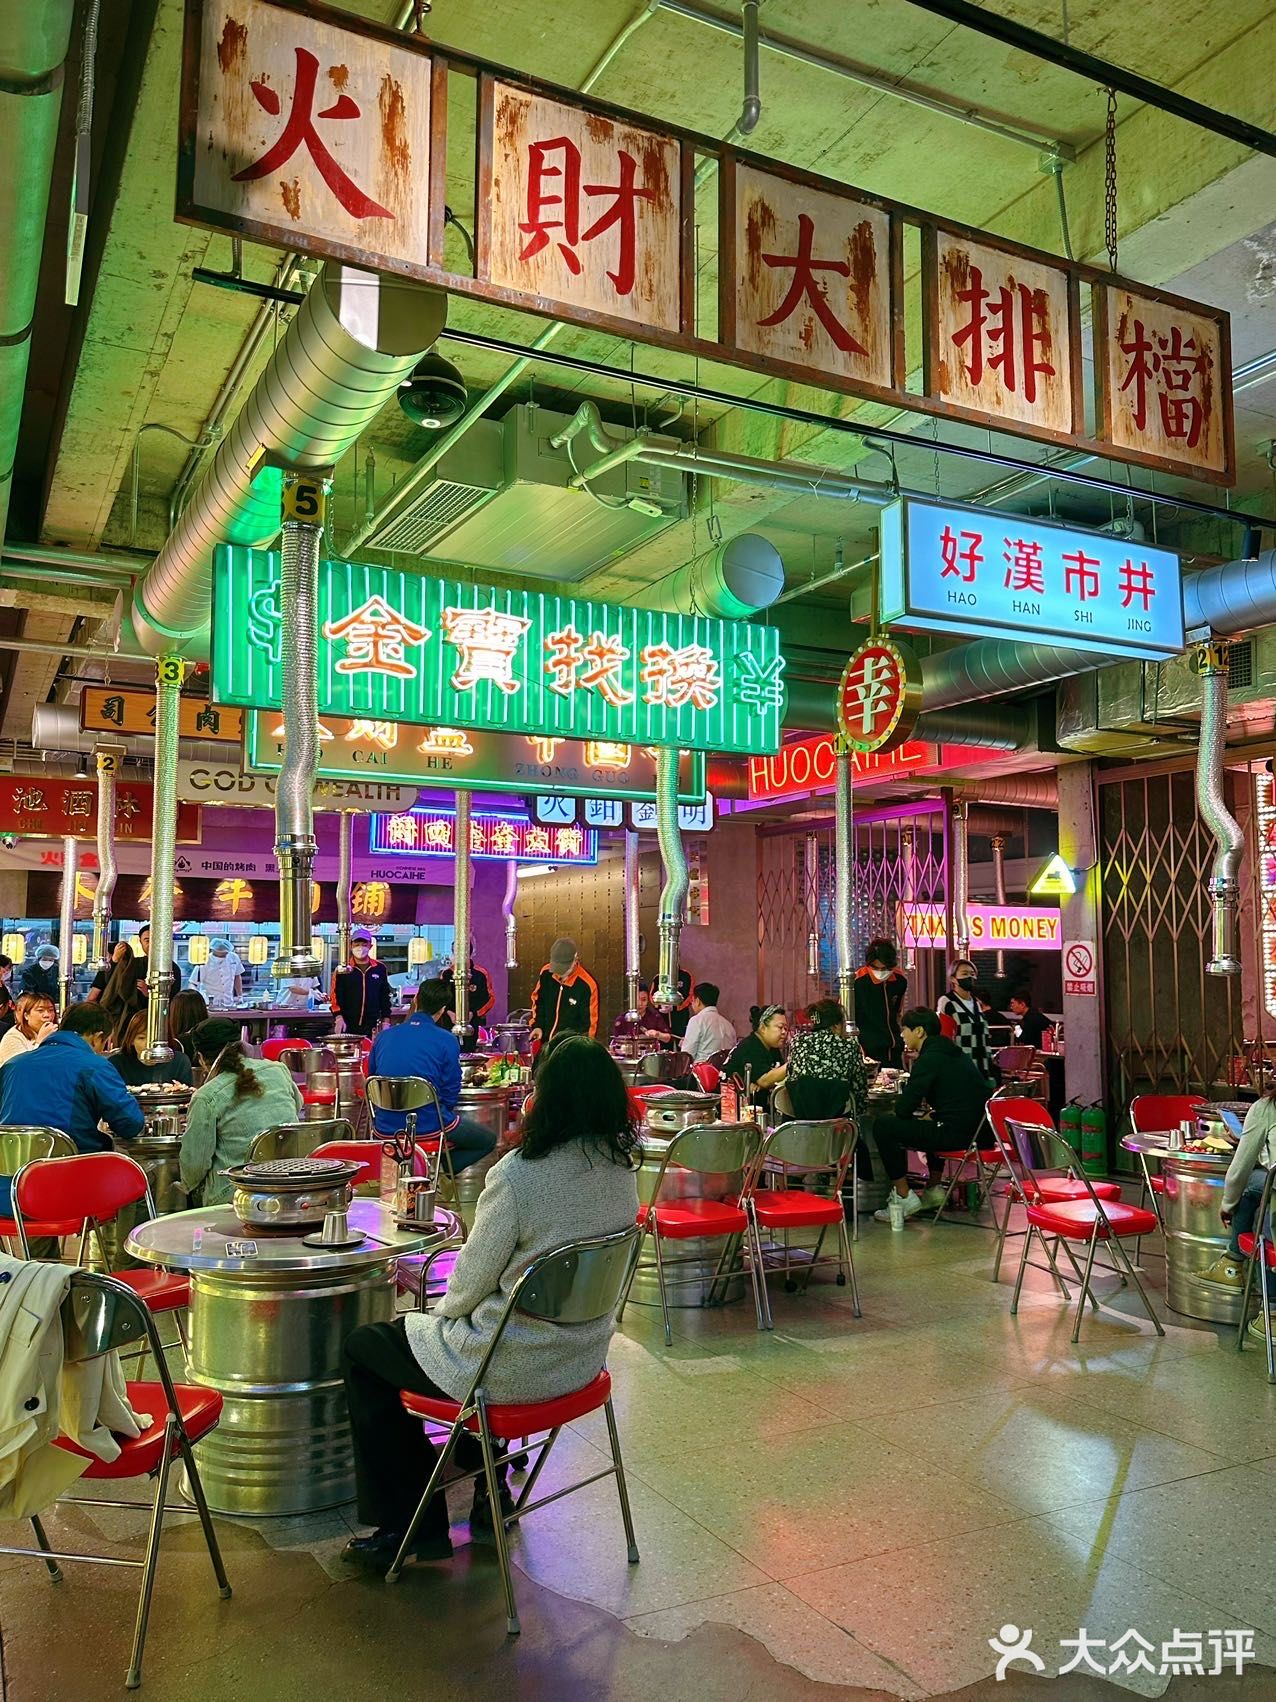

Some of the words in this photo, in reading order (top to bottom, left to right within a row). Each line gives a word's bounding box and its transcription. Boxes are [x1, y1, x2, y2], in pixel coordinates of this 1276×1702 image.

[231, 47, 1202, 448] 火財大排檔
[296, 485, 318, 515] 5
[940, 525, 1156, 612] 好漢市井
[947, 591, 977, 605] HAO
[1012, 600, 1041, 615] HAN
[1074, 610, 1093, 623] SHI
[1127, 618, 1152, 632] JING
[164, 662, 179, 681] 3
[103, 757, 114, 770] 2
[352, 750, 388, 765] CAI
[427, 755, 453, 770] HE
[189, 768, 256, 792] GOD
[201, 860, 256, 873] 中国的烤肉
[370, 869, 426, 881] HUOCAIHE
[991, 917, 1059, 939] MONEY
